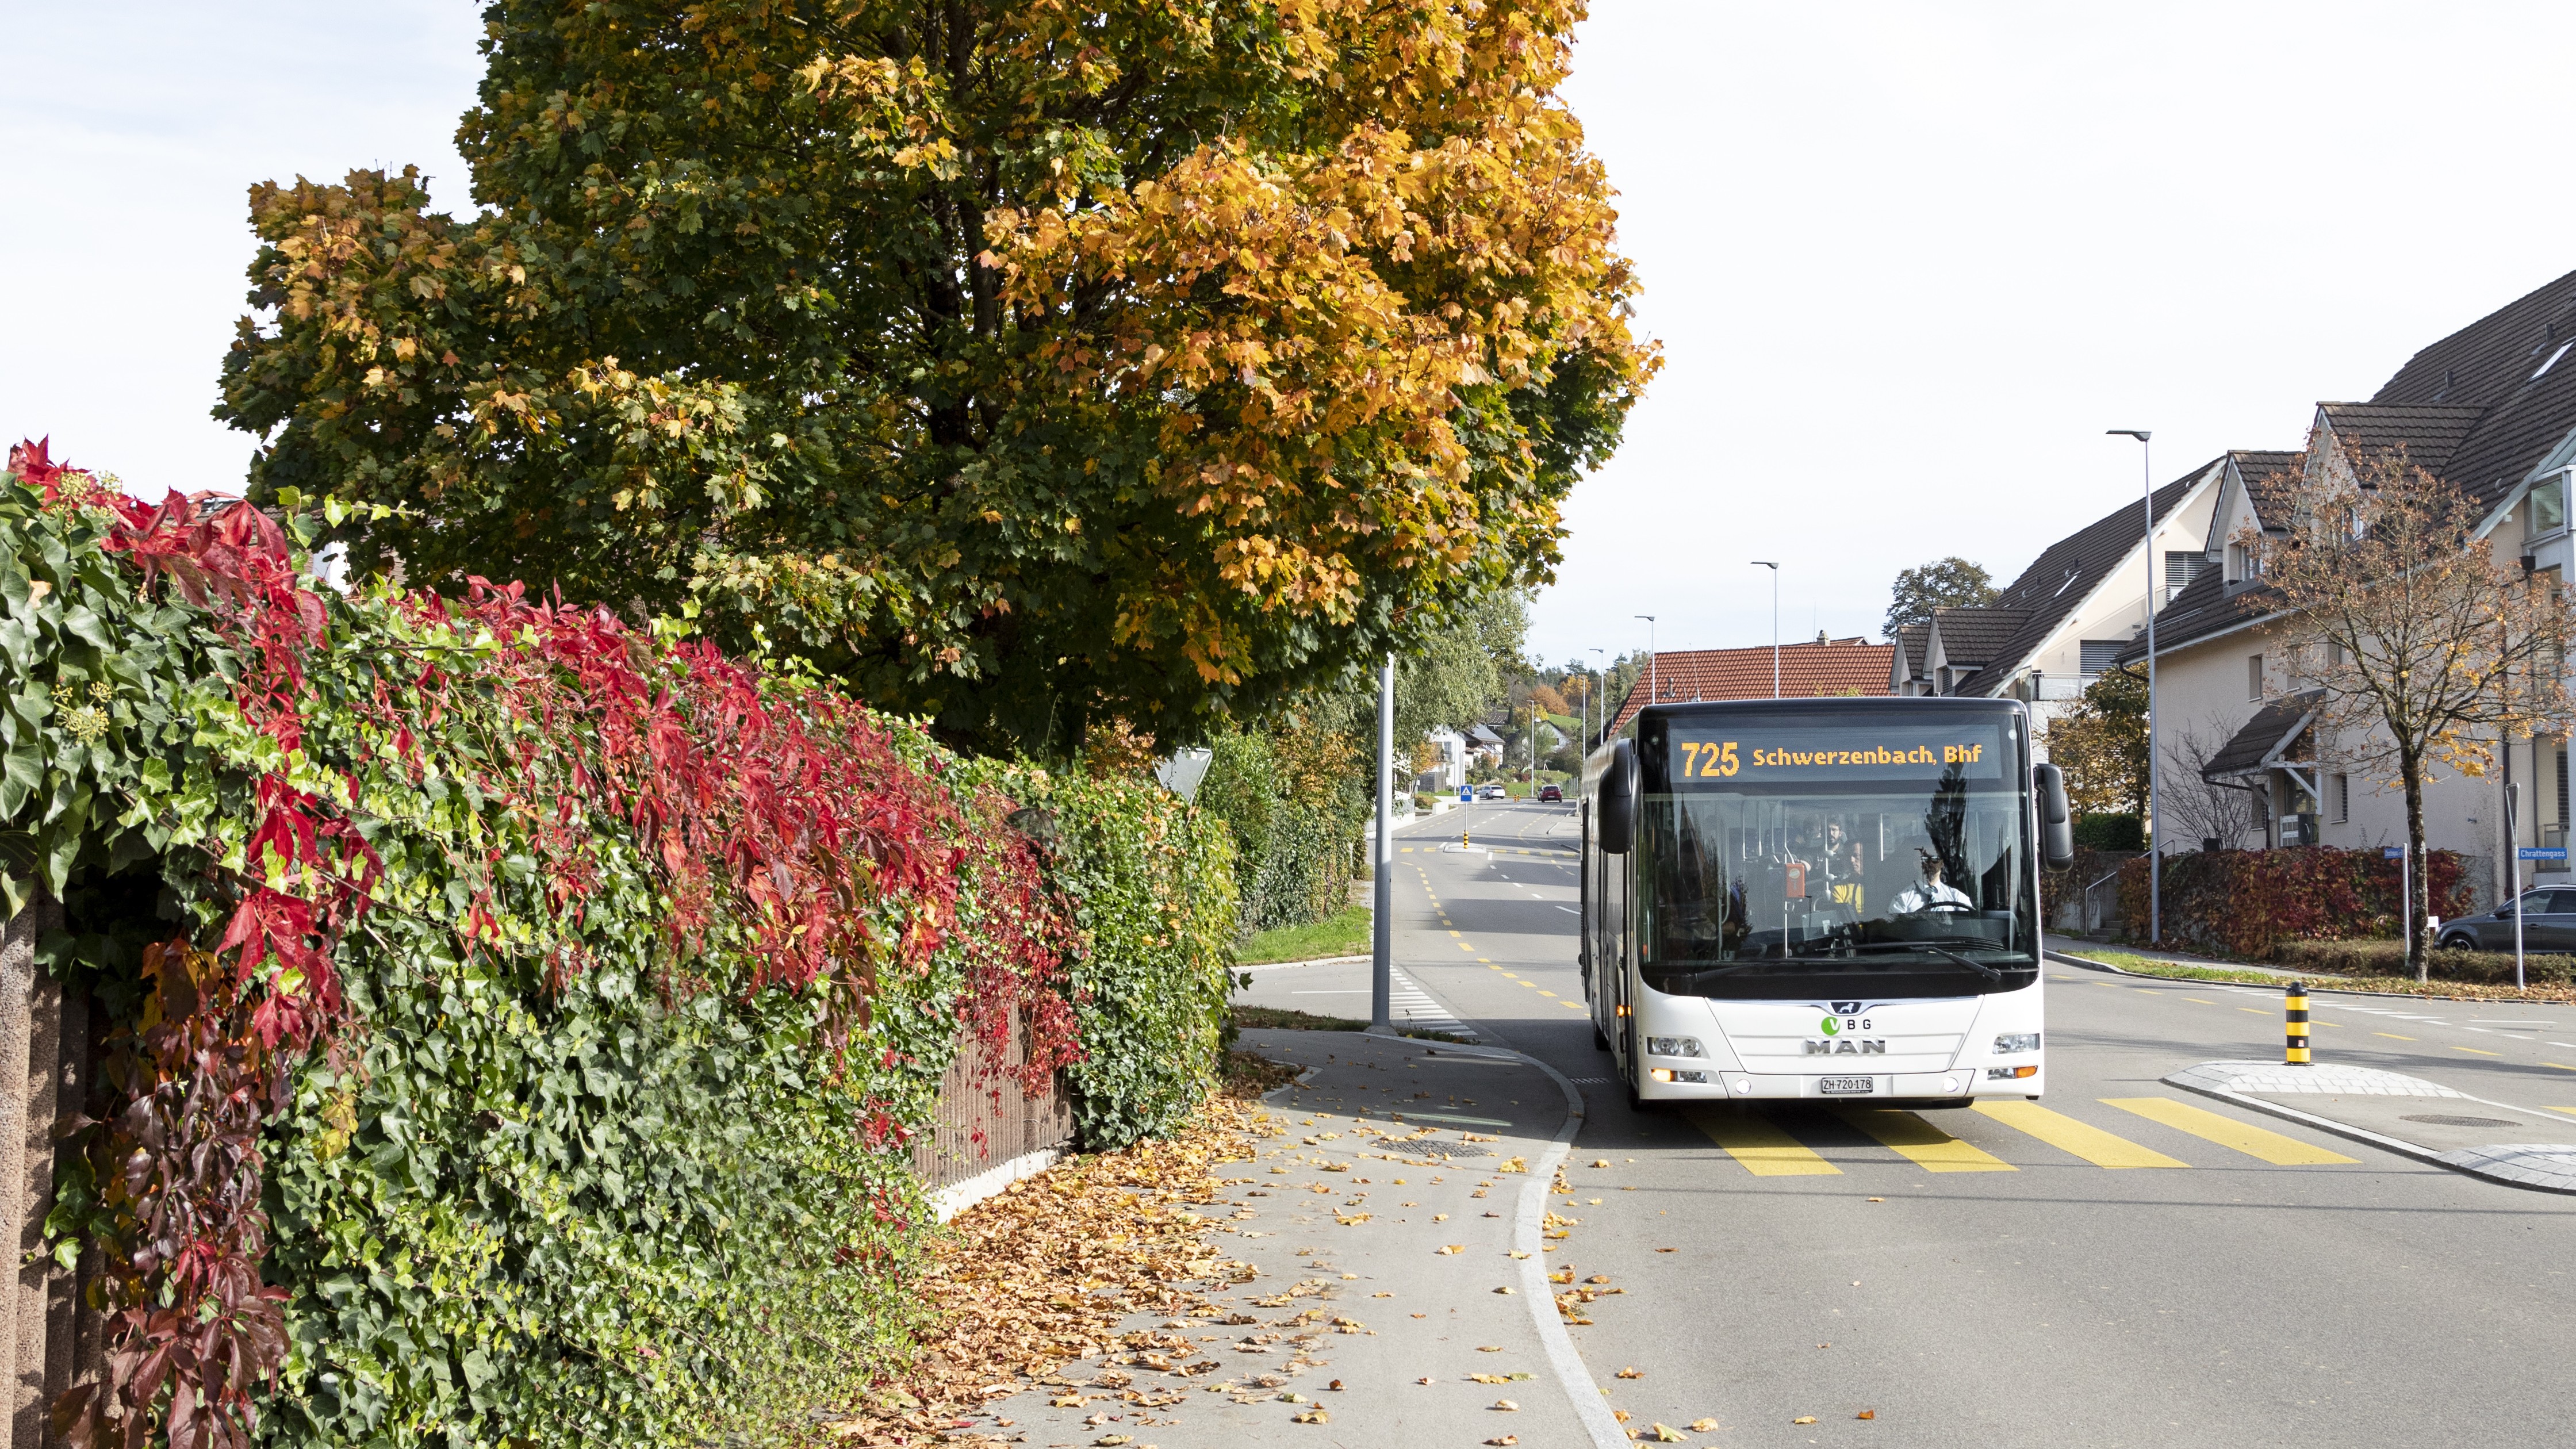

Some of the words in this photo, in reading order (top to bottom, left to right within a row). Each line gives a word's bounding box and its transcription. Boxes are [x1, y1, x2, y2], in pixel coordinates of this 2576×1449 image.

[1681, 742, 1739, 777] 725
[1753, 745, 1937, 766] Schwerzenbach,
[1943, 743, 1983, 763] Bhf
[2520, 850, 2566, 859] Chrattengass
[1807, 1039, 1885, 1054] MAN
